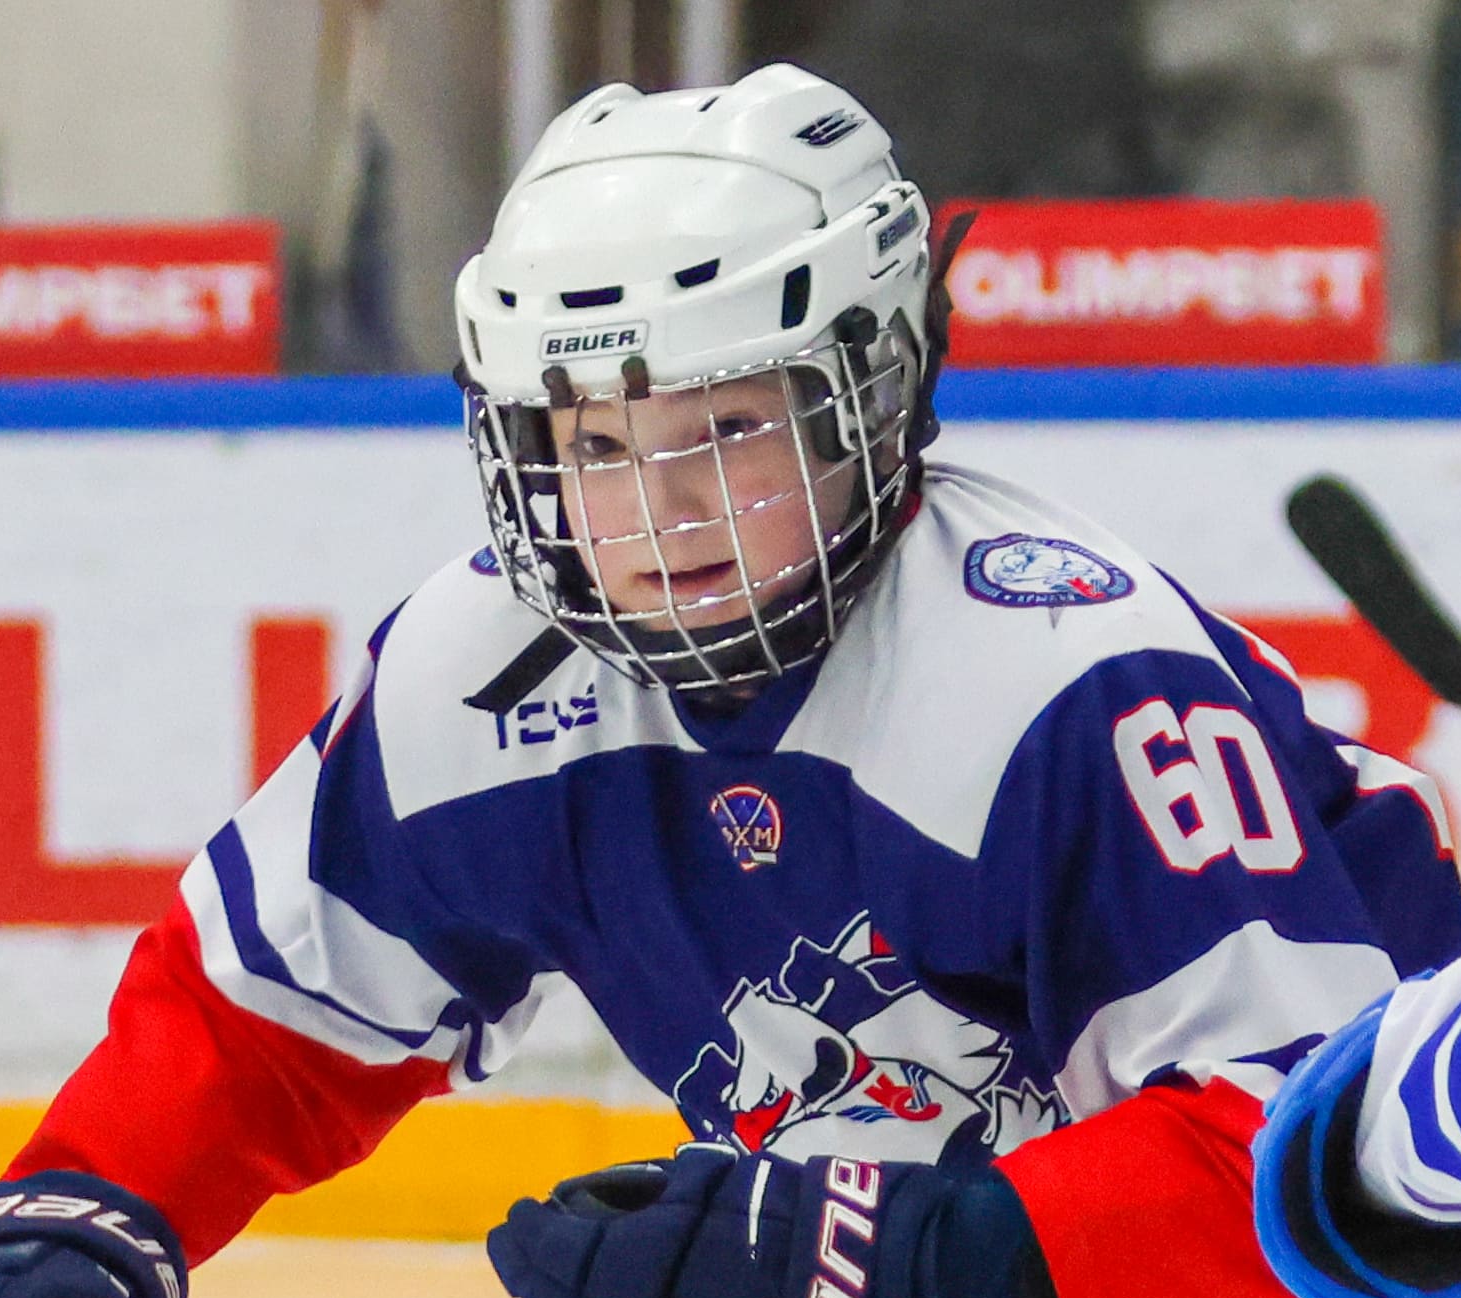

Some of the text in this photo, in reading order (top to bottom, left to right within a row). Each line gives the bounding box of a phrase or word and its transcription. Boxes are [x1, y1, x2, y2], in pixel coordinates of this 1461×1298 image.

[947, 245, 1376, 320] OLIMPBET
[546, 329, 636, 354] BAUER
[1112, 696, 1306, 874] 60
